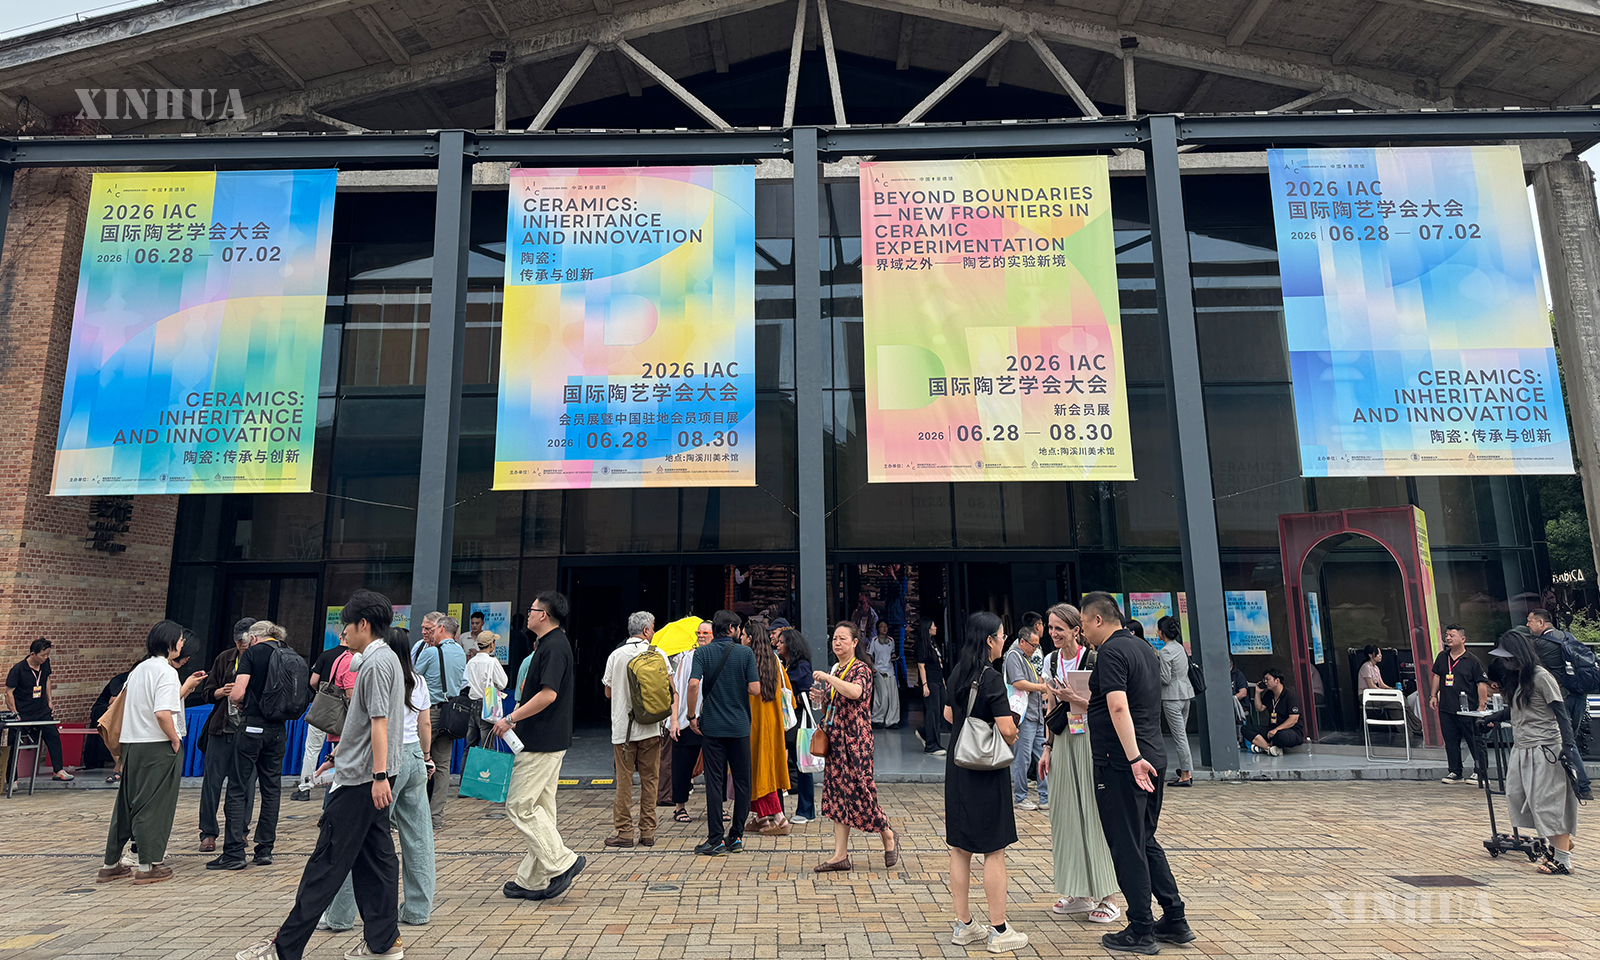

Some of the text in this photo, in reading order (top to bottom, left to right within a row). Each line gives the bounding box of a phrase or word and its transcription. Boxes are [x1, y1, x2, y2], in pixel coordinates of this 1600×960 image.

[874, 186, 1093, 205] BEYOND BOUNDARIES
[1286, 180, 1382, 196] 2026 IAC
[102, 203, 198, 220] 2026 IAC
[523, 197, 638, 212] CERAMICS:
[898, 207, 944, 221] NEW
[951, 204, 1063, 220] FRONTIERS
[1070, 203, 1089, 217] IN
[1289, 198, 1464, 220] 国际陶艺学会大会
[523, 213, 662, 229] INHERITANCE
[100, 221, 271, 243] 国际陶艺学会大会
[522, 229, 703, 245] AND INNOVATION
[875, 223, 968, 238] CERAMIC
[1291, 232, 1316, 240] 2026
[1329, 225, 1390, 241] 06.28
[1419, 224, 1482, 240] 07.02
[96, 254, 122, 263] 2026
[134, 247, 194, 263] 06.28
[221, 246, 282, 262] 07.02
[876, 238, 1065, 255] EXPERIMENTATION
[520, 267, 594, 282] 传承与创新
[641, 362, 739, 379] 2026 IAC
[1006, 354, 1106, 372] 2026 IAC
[928, 374, 1108, 397] 国际陶艺学会大会
[1418, 370, 1542, 386] CERAMICS:
[186, 391, 305, 407] CERAMICS:
[563, 382, 739, 404] 国际陶艺学会大会
[1394, 388, 1546, 404] INHERITANCE
[159, 409, 303, 426] INHERITANCE
[559, 411, 739, 426] 会员展暨中国驻地会员项目展
[1053, 403, 1110, 417] 新会员展
[1353, 406, 1548, 423] AND INNOVATION
[112, 427, 301, 444] AND INNOVATION
[547, 438, 574, 448] 2026
[586, 431, 648, 449] 06.28
[677, 430, 739, 447] 08.30
[918, 432, 944, 441] 2026
[957, 425, 1019, 442] 06.28
[1049, 424, 1112, 441] 08.30
